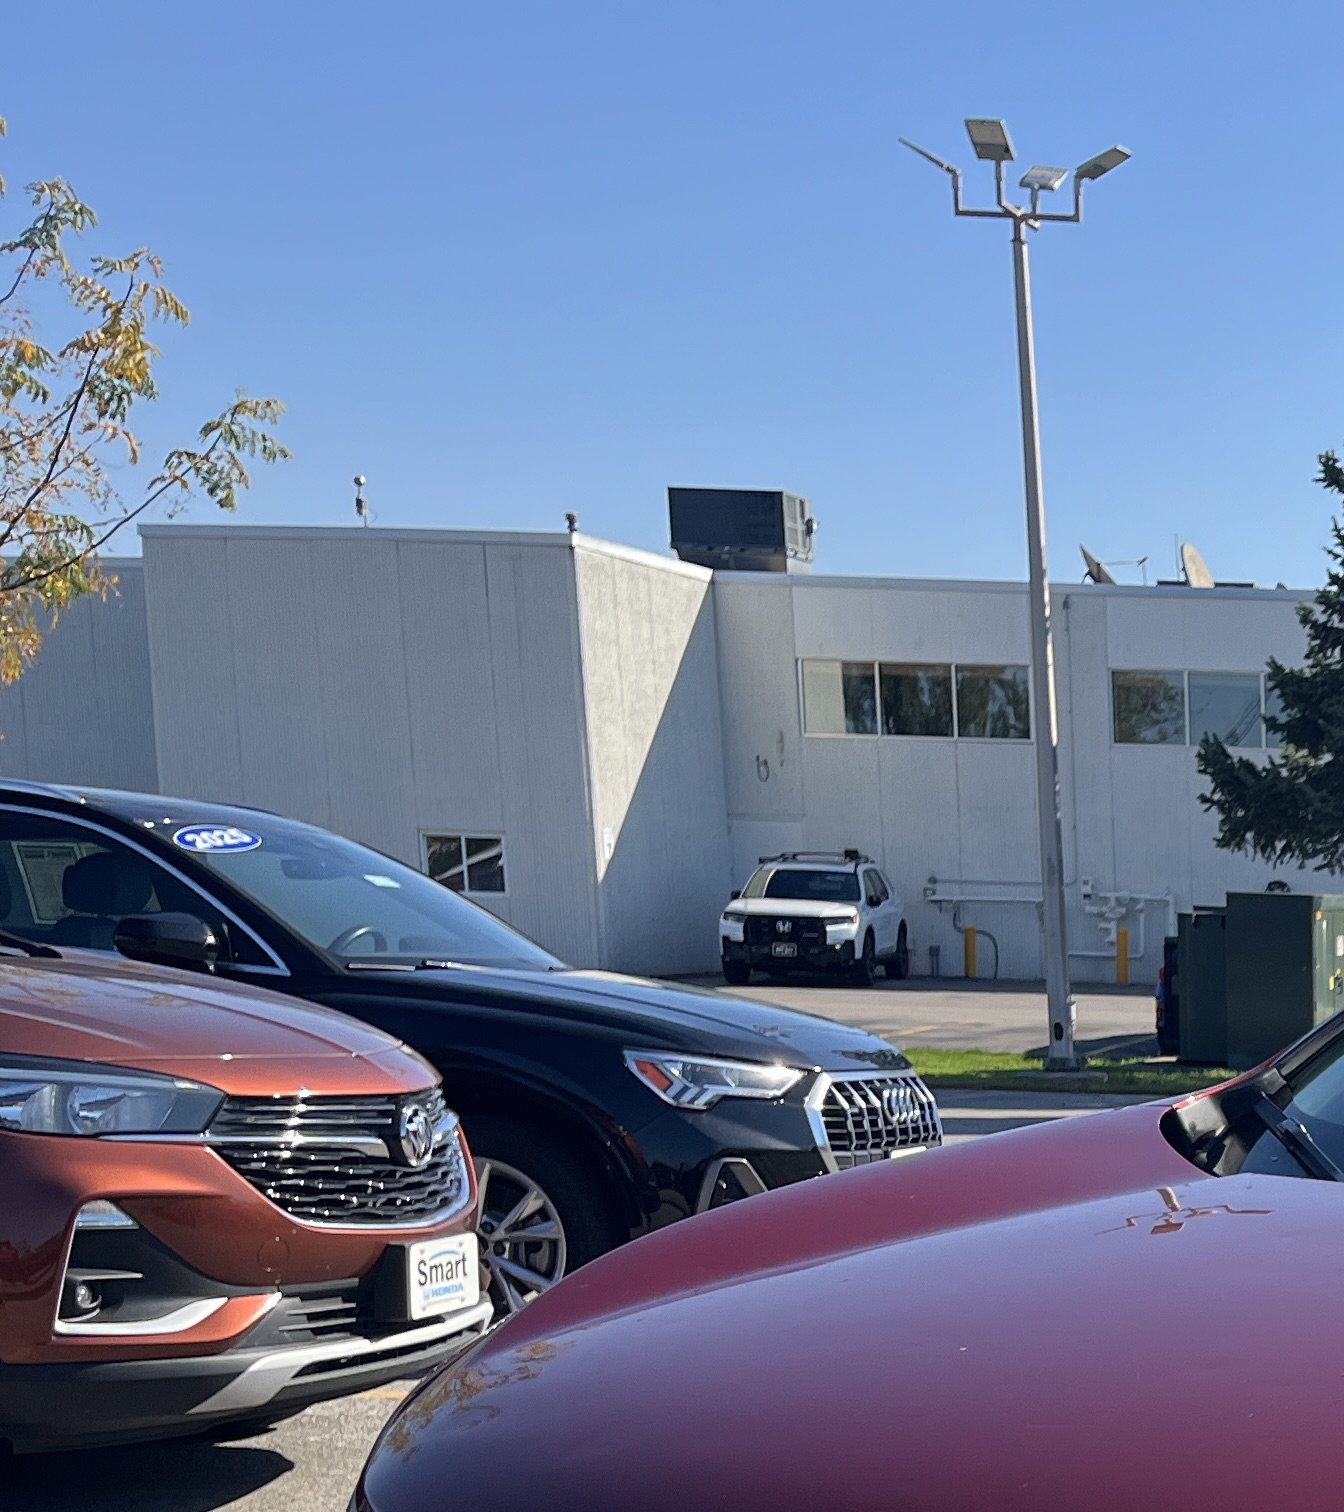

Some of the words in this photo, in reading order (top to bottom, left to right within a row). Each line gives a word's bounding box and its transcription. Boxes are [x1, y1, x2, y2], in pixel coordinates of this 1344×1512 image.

[183, 828, 252, 849] 2025
[418, 1252, 467, 1286] Smart
[432, 1283, 464, 1298] HONDA
